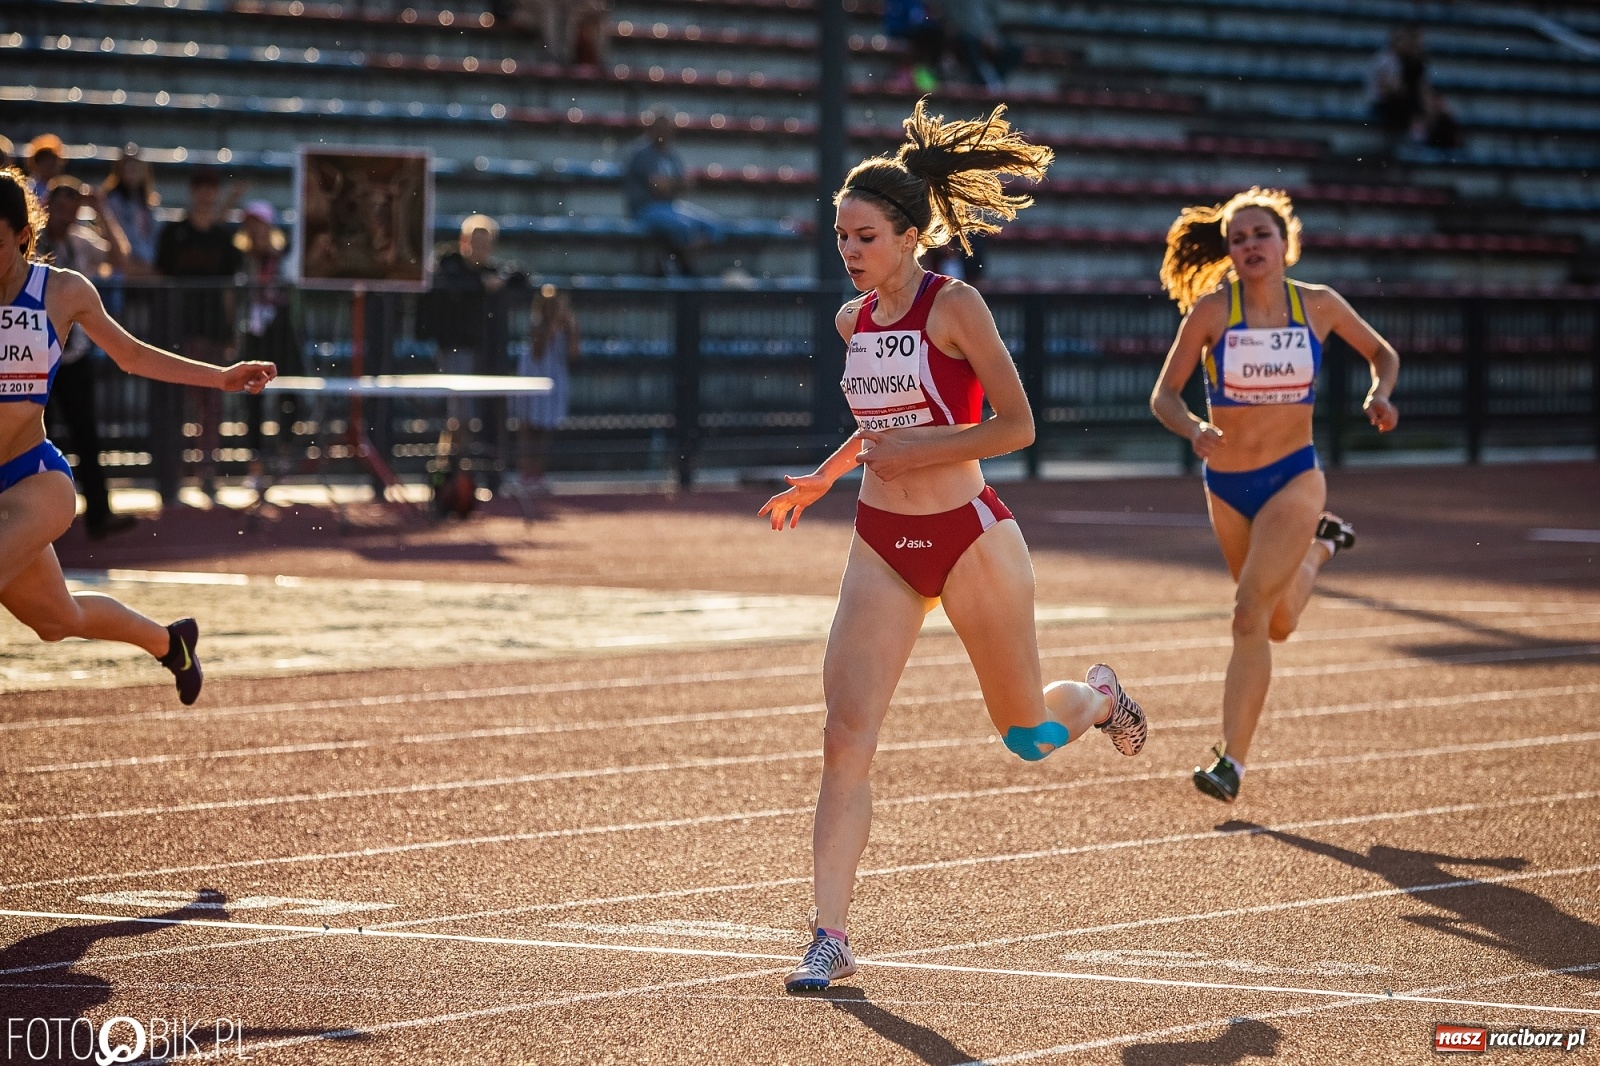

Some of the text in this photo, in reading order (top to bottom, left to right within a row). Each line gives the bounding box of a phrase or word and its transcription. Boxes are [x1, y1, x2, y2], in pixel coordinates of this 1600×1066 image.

[0, 310, 42, 331] 541
[875, 335, 915, 358] 390
[1270, 331, 1306, 351] 372
[1242, 362, 1296, 378] DYBKA
[10, 382, 34, 392] 2019
[891, 413, 917, 427] 2019
